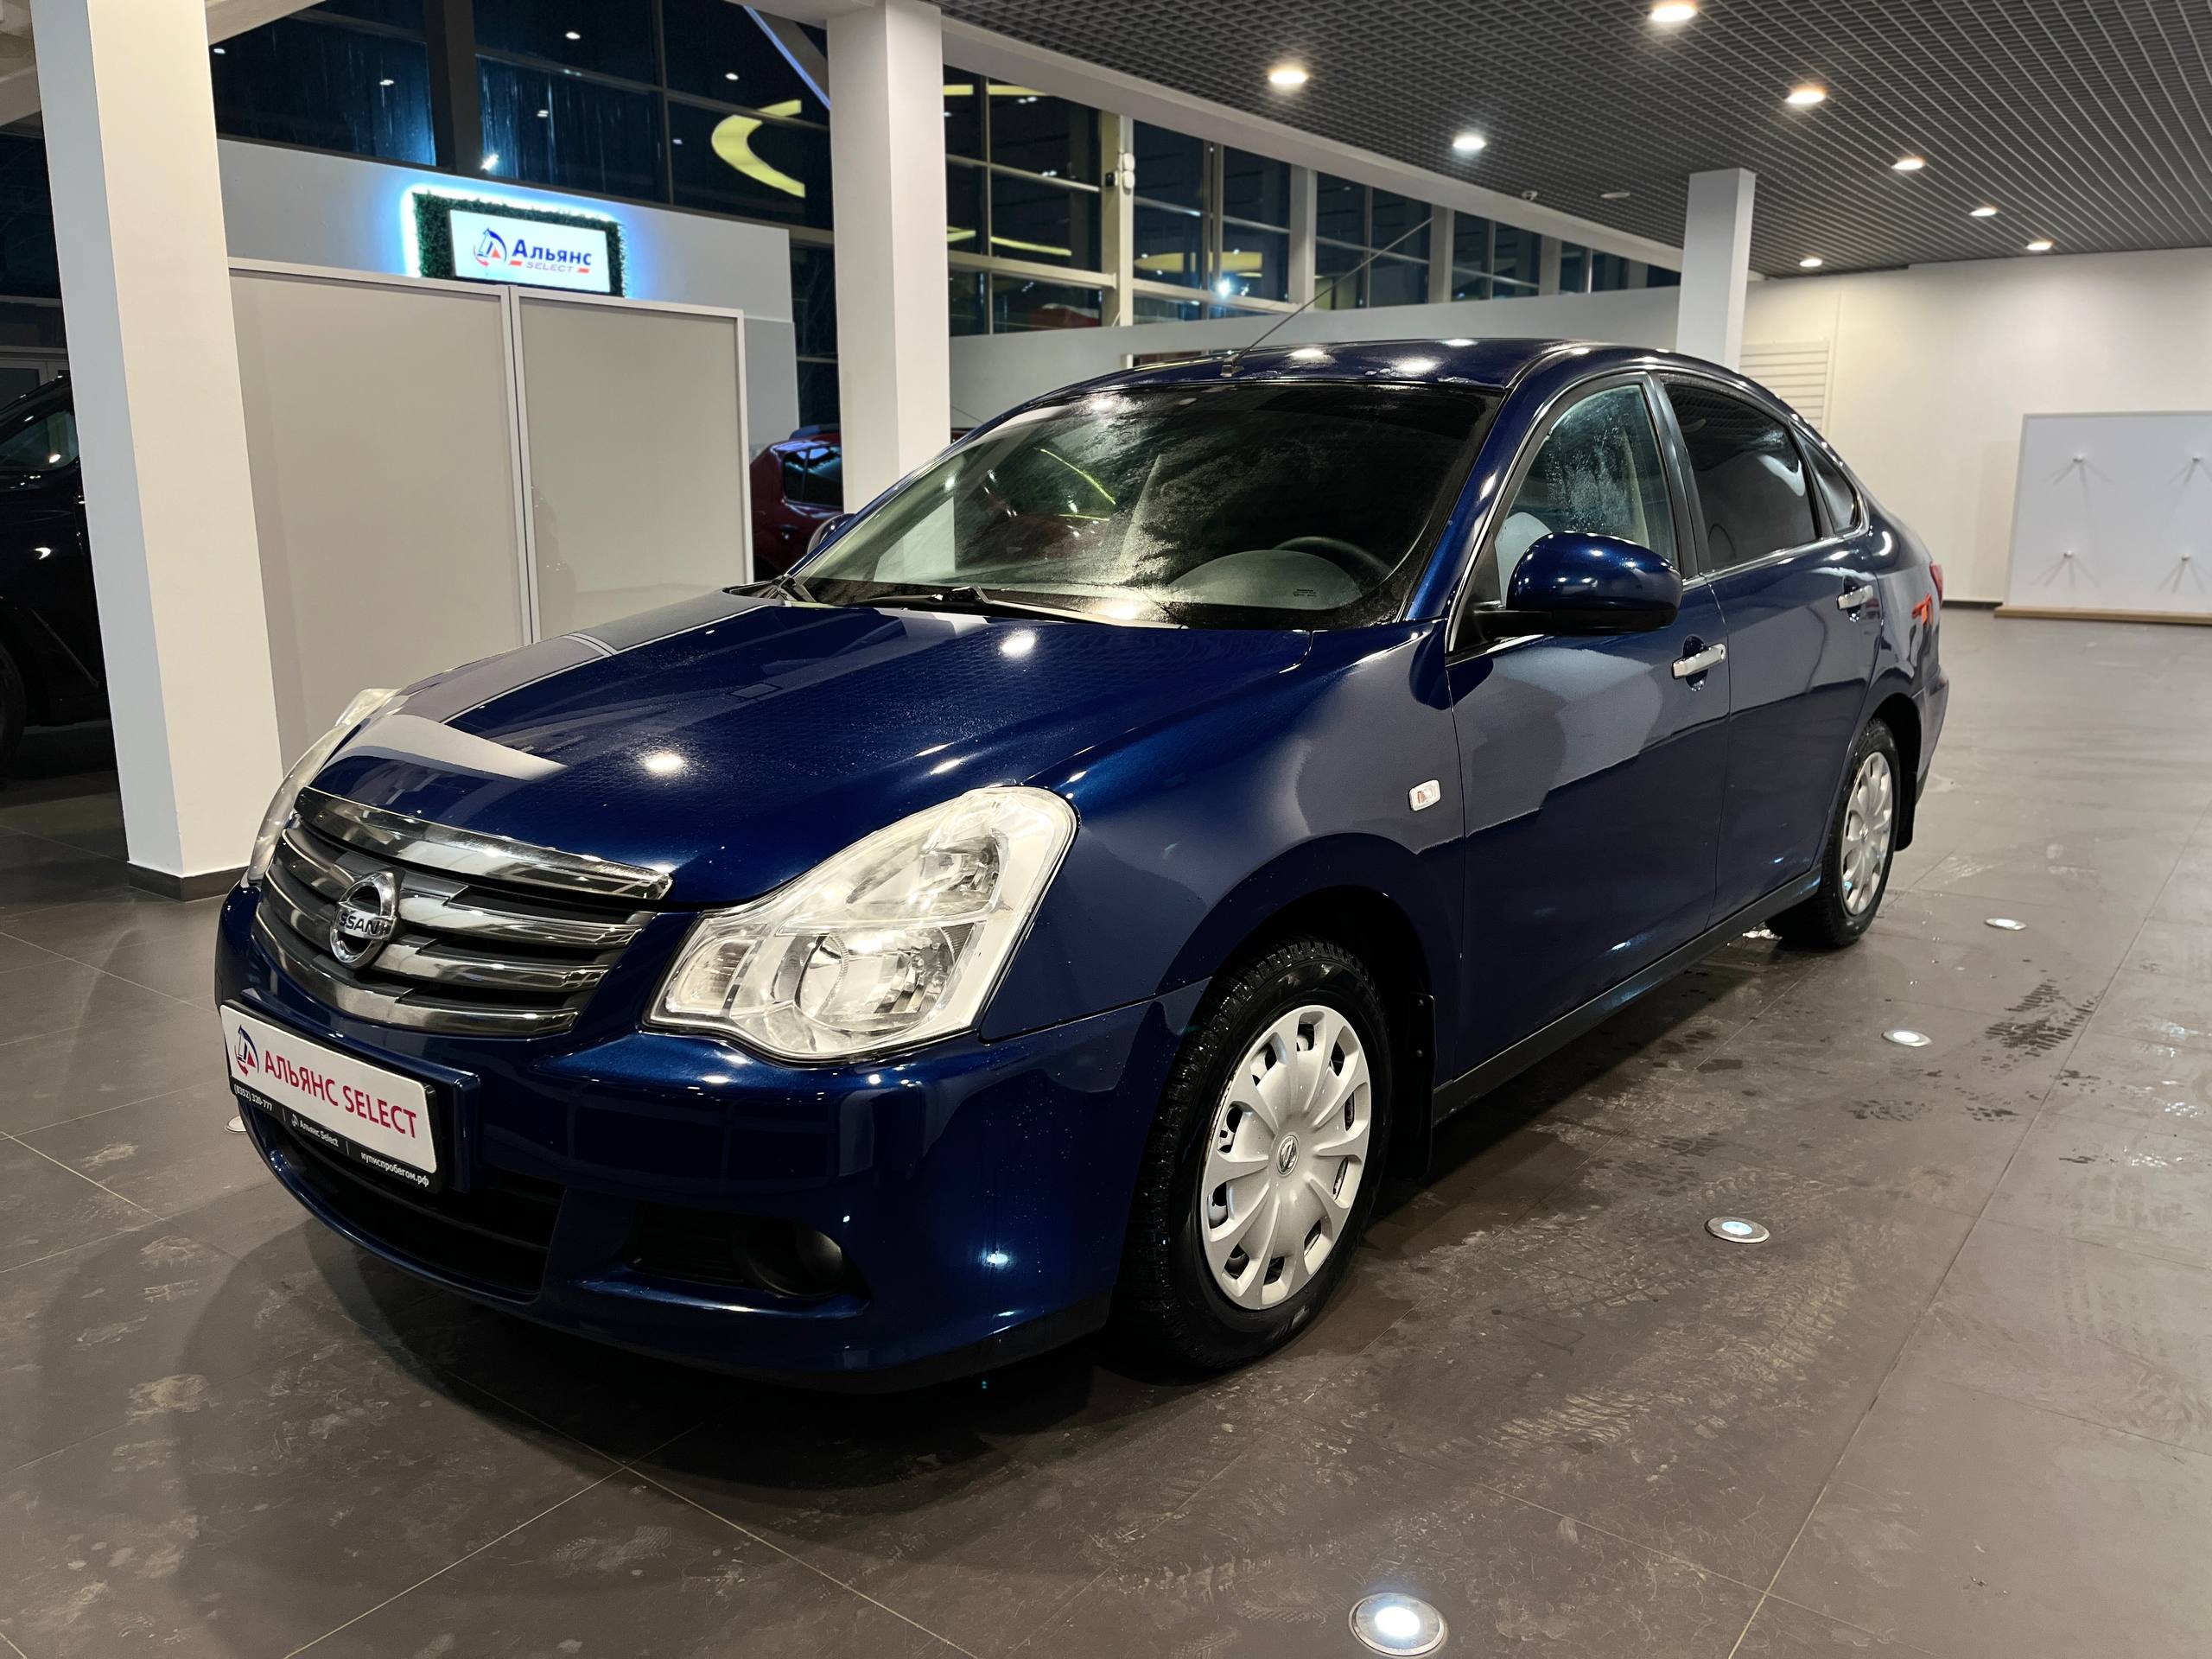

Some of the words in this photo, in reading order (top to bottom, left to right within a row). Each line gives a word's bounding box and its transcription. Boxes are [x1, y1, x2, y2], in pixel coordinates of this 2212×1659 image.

[512, 238, 592, 265] Альянс
[526, 261, 574, 273] SELECT
[337, 911, 380, 935] SSAN
[233, 1084, 251, 1102] (8352)
[264, 1050, 339, 1107] АЛЬЯНС
[342, 1084, 416, 1139] SELECT
[360, 1151, 429, 1187] куписпробегом.рф
